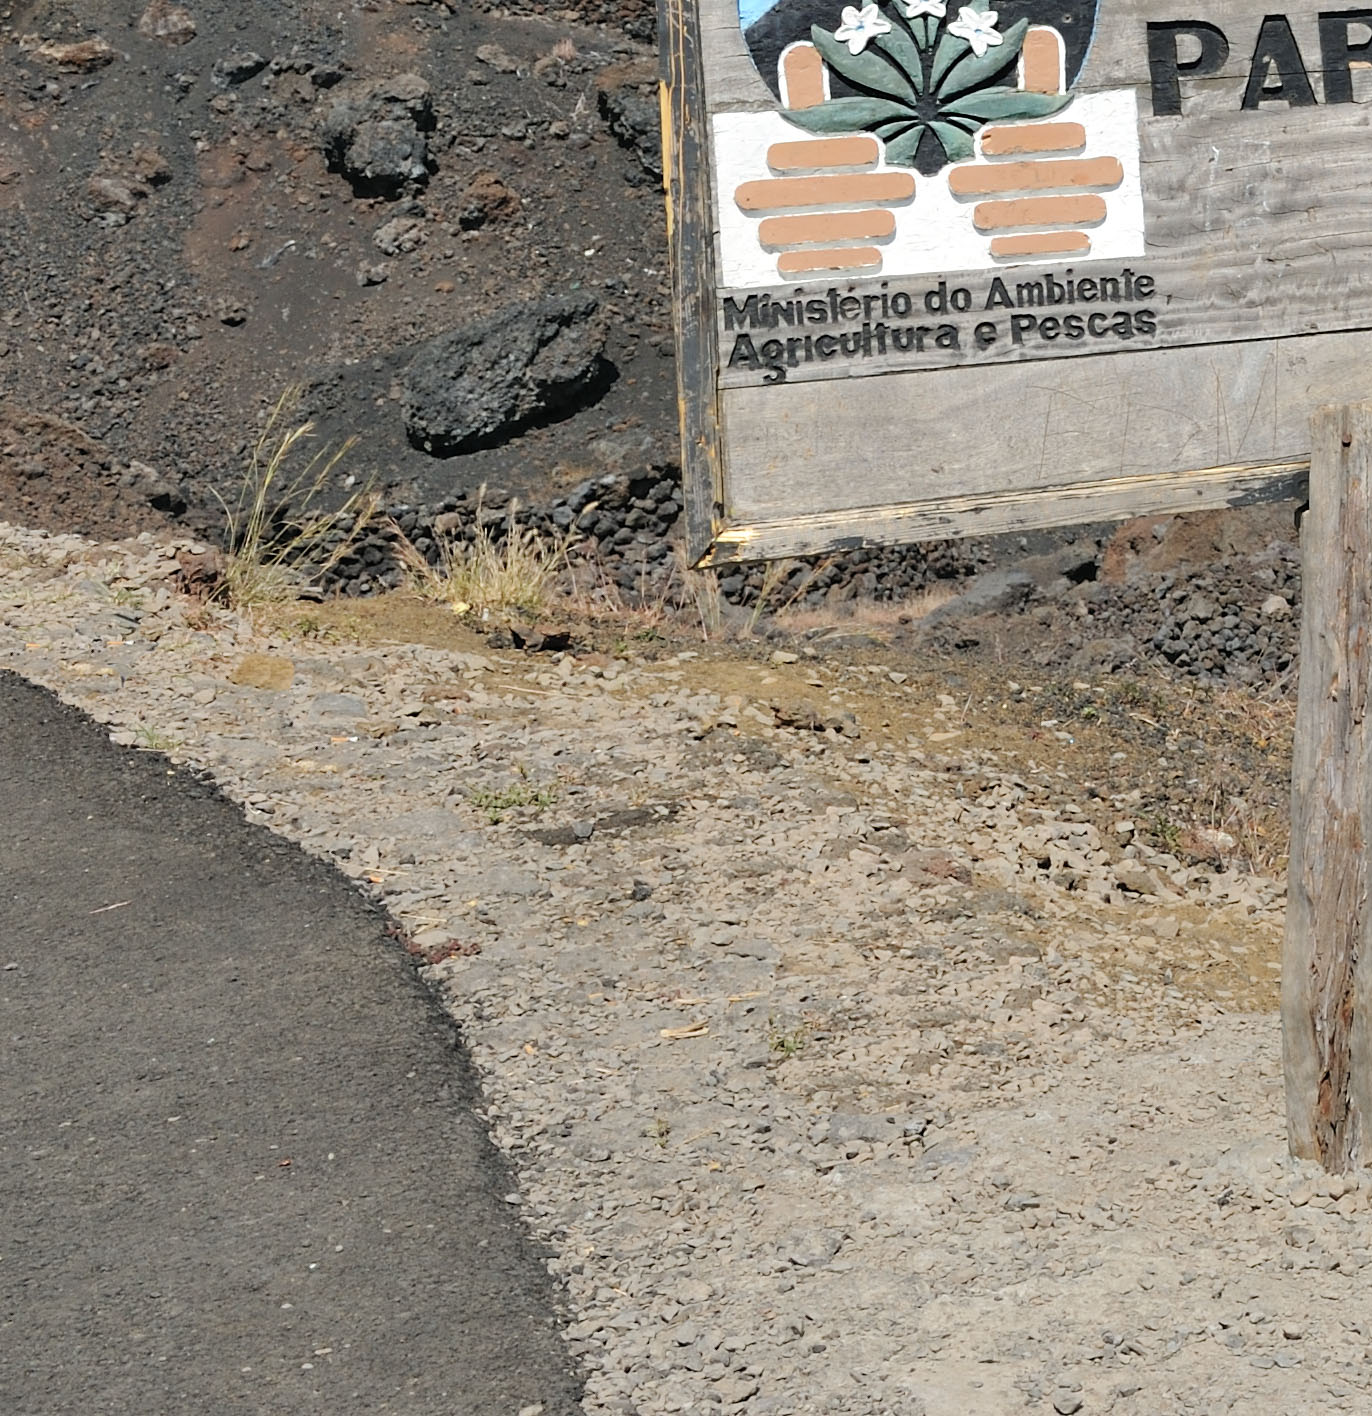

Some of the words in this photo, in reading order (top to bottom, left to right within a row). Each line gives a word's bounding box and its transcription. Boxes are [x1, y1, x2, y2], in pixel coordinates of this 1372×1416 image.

[924, 281, 972, 315] do
[728, 320, 960, 383] Agricultura
[974, 320, 997, 350] e
[1010, 308, 1157, 345] Pescas
